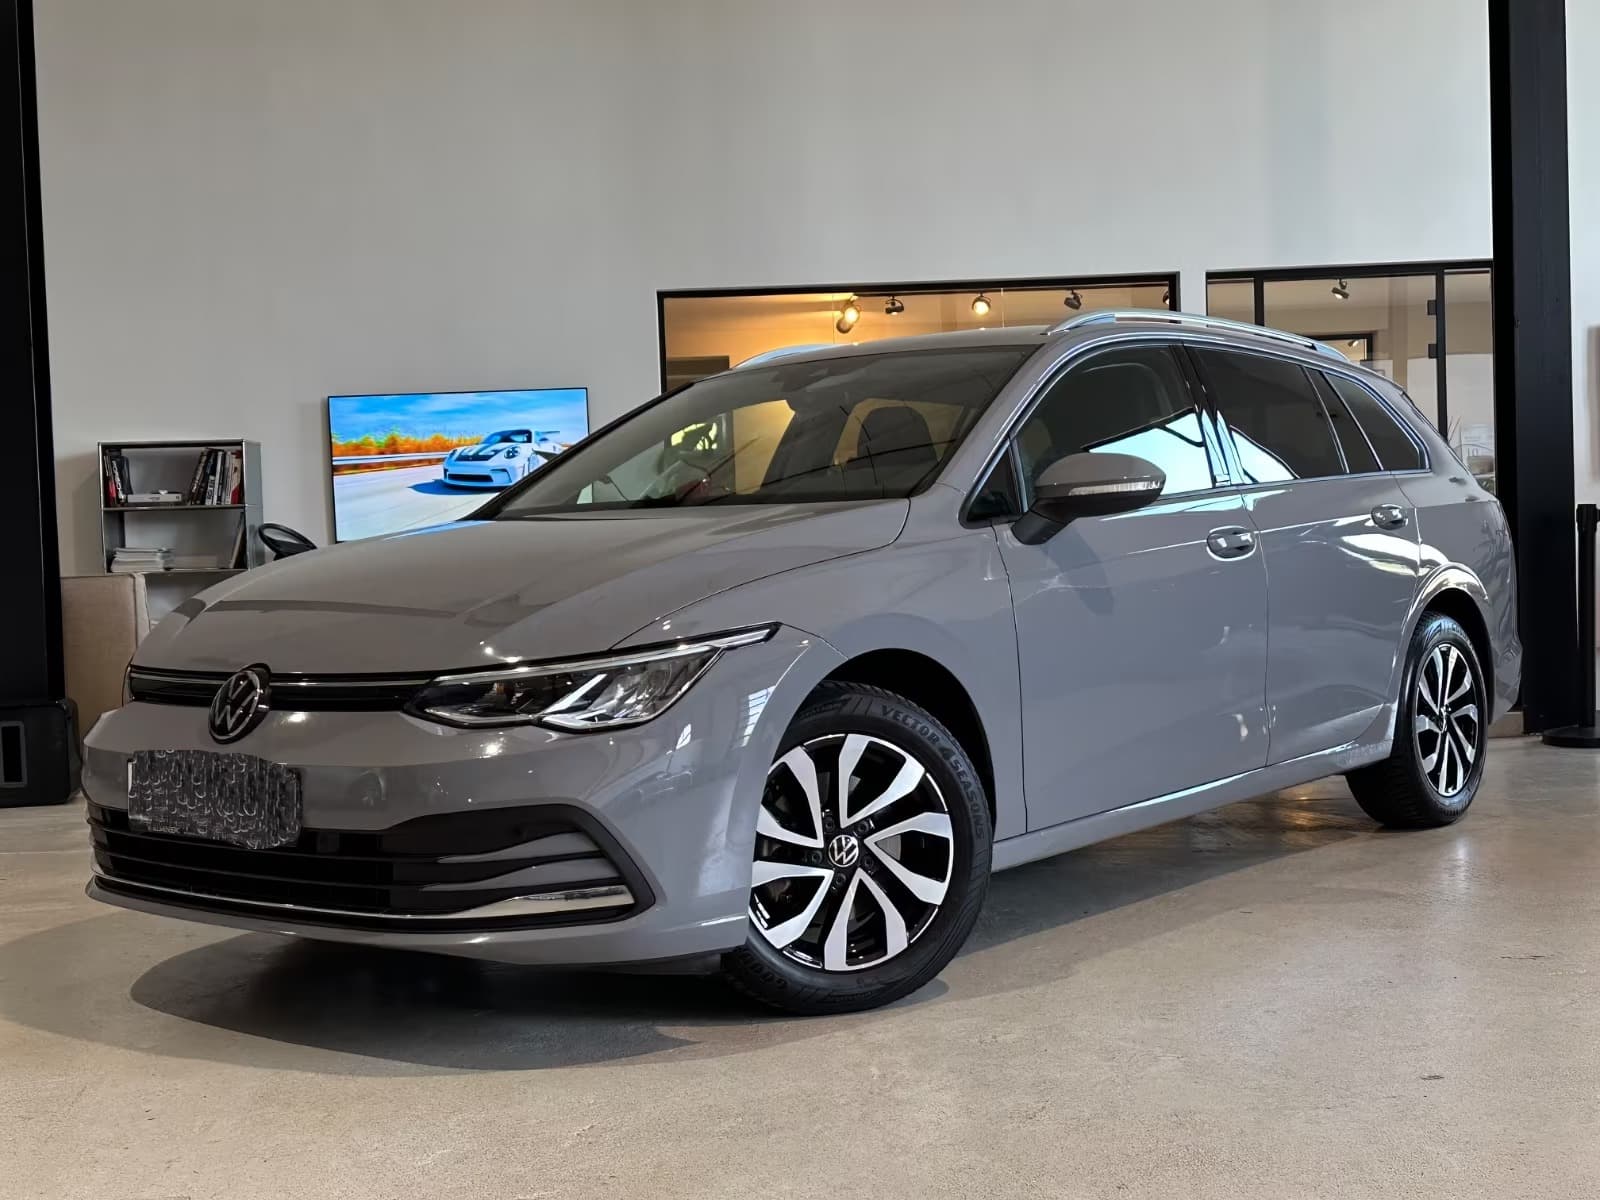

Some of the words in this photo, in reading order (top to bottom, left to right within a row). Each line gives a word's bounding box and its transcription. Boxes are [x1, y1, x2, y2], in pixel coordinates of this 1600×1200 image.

[211, 673, 258, 734] VW
[880, 704, 941, 745] VECTOR
[830, 835, 858, 866] VW
